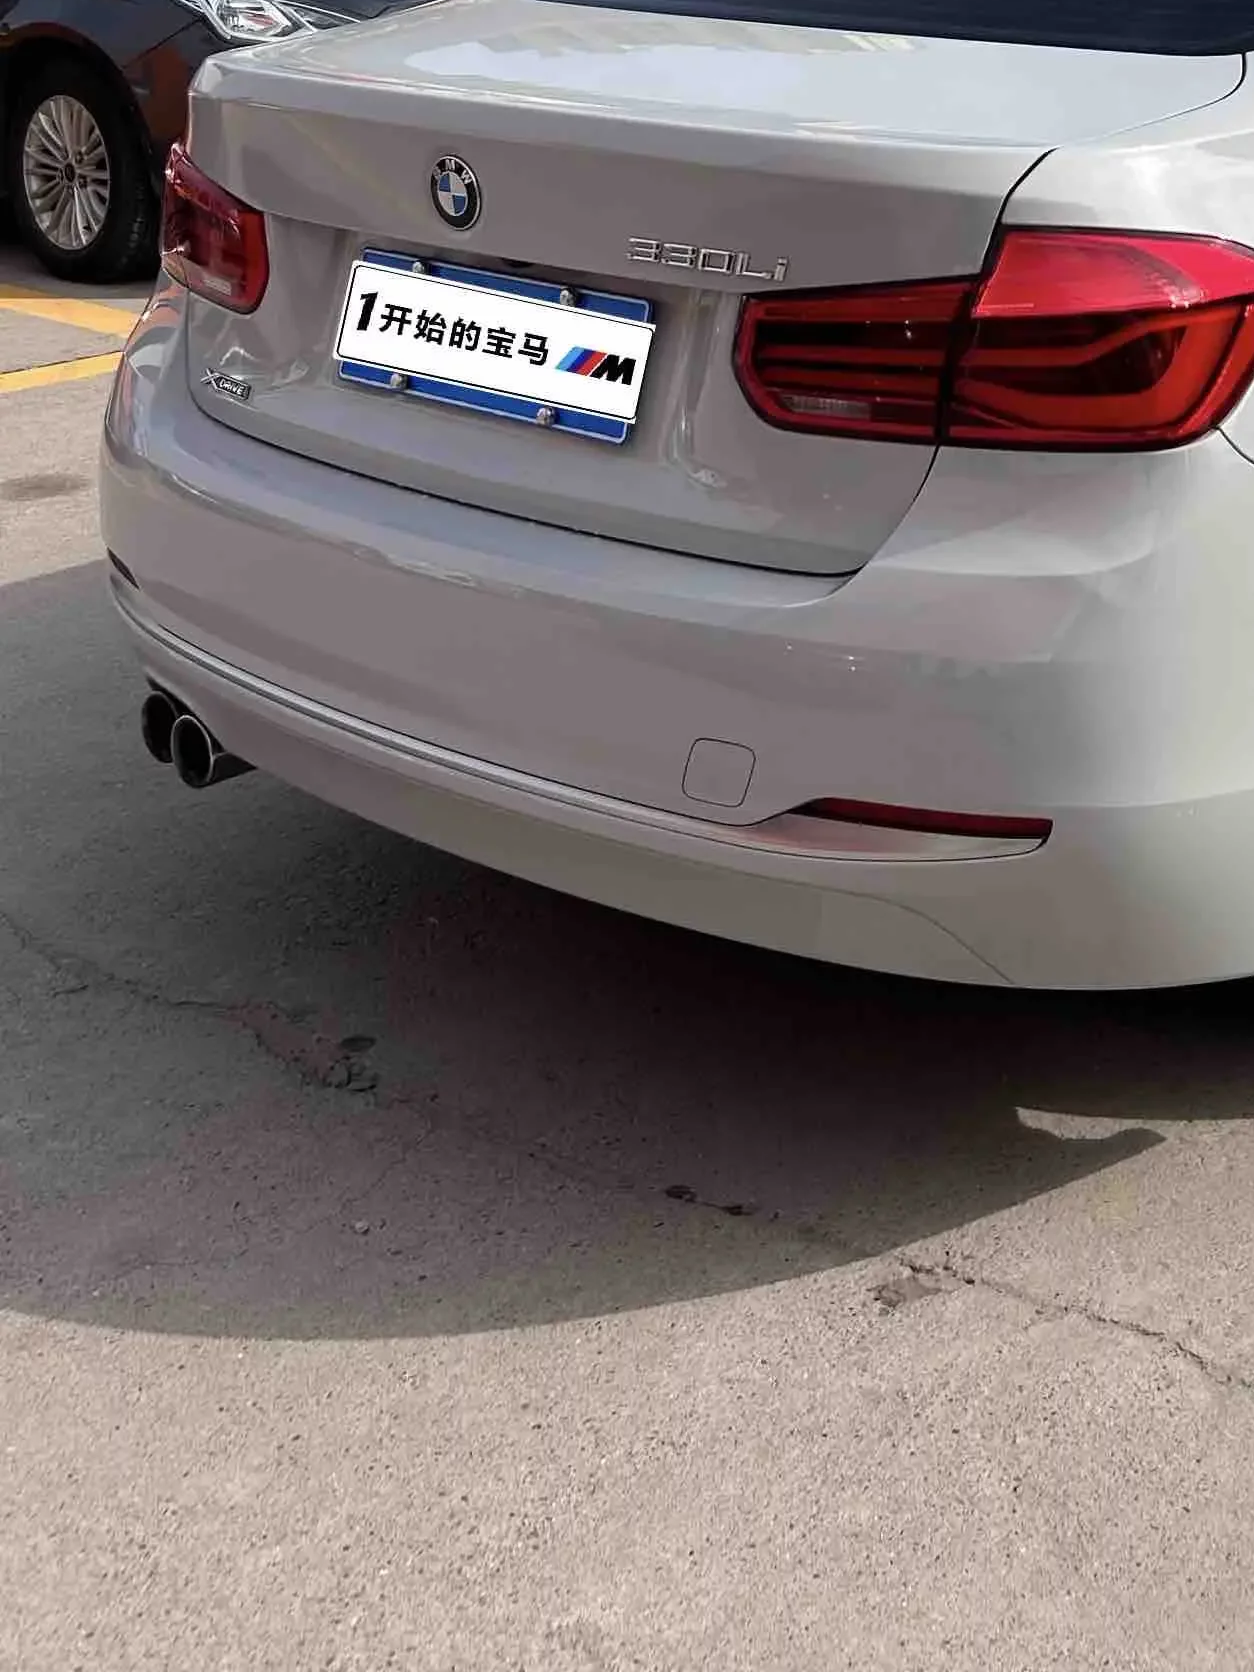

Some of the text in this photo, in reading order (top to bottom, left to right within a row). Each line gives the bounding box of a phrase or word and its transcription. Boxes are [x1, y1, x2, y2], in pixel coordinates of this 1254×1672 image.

[626, 236, 789, 282] 330Li
[356, 291, 549, 366] 1开始的宝马
